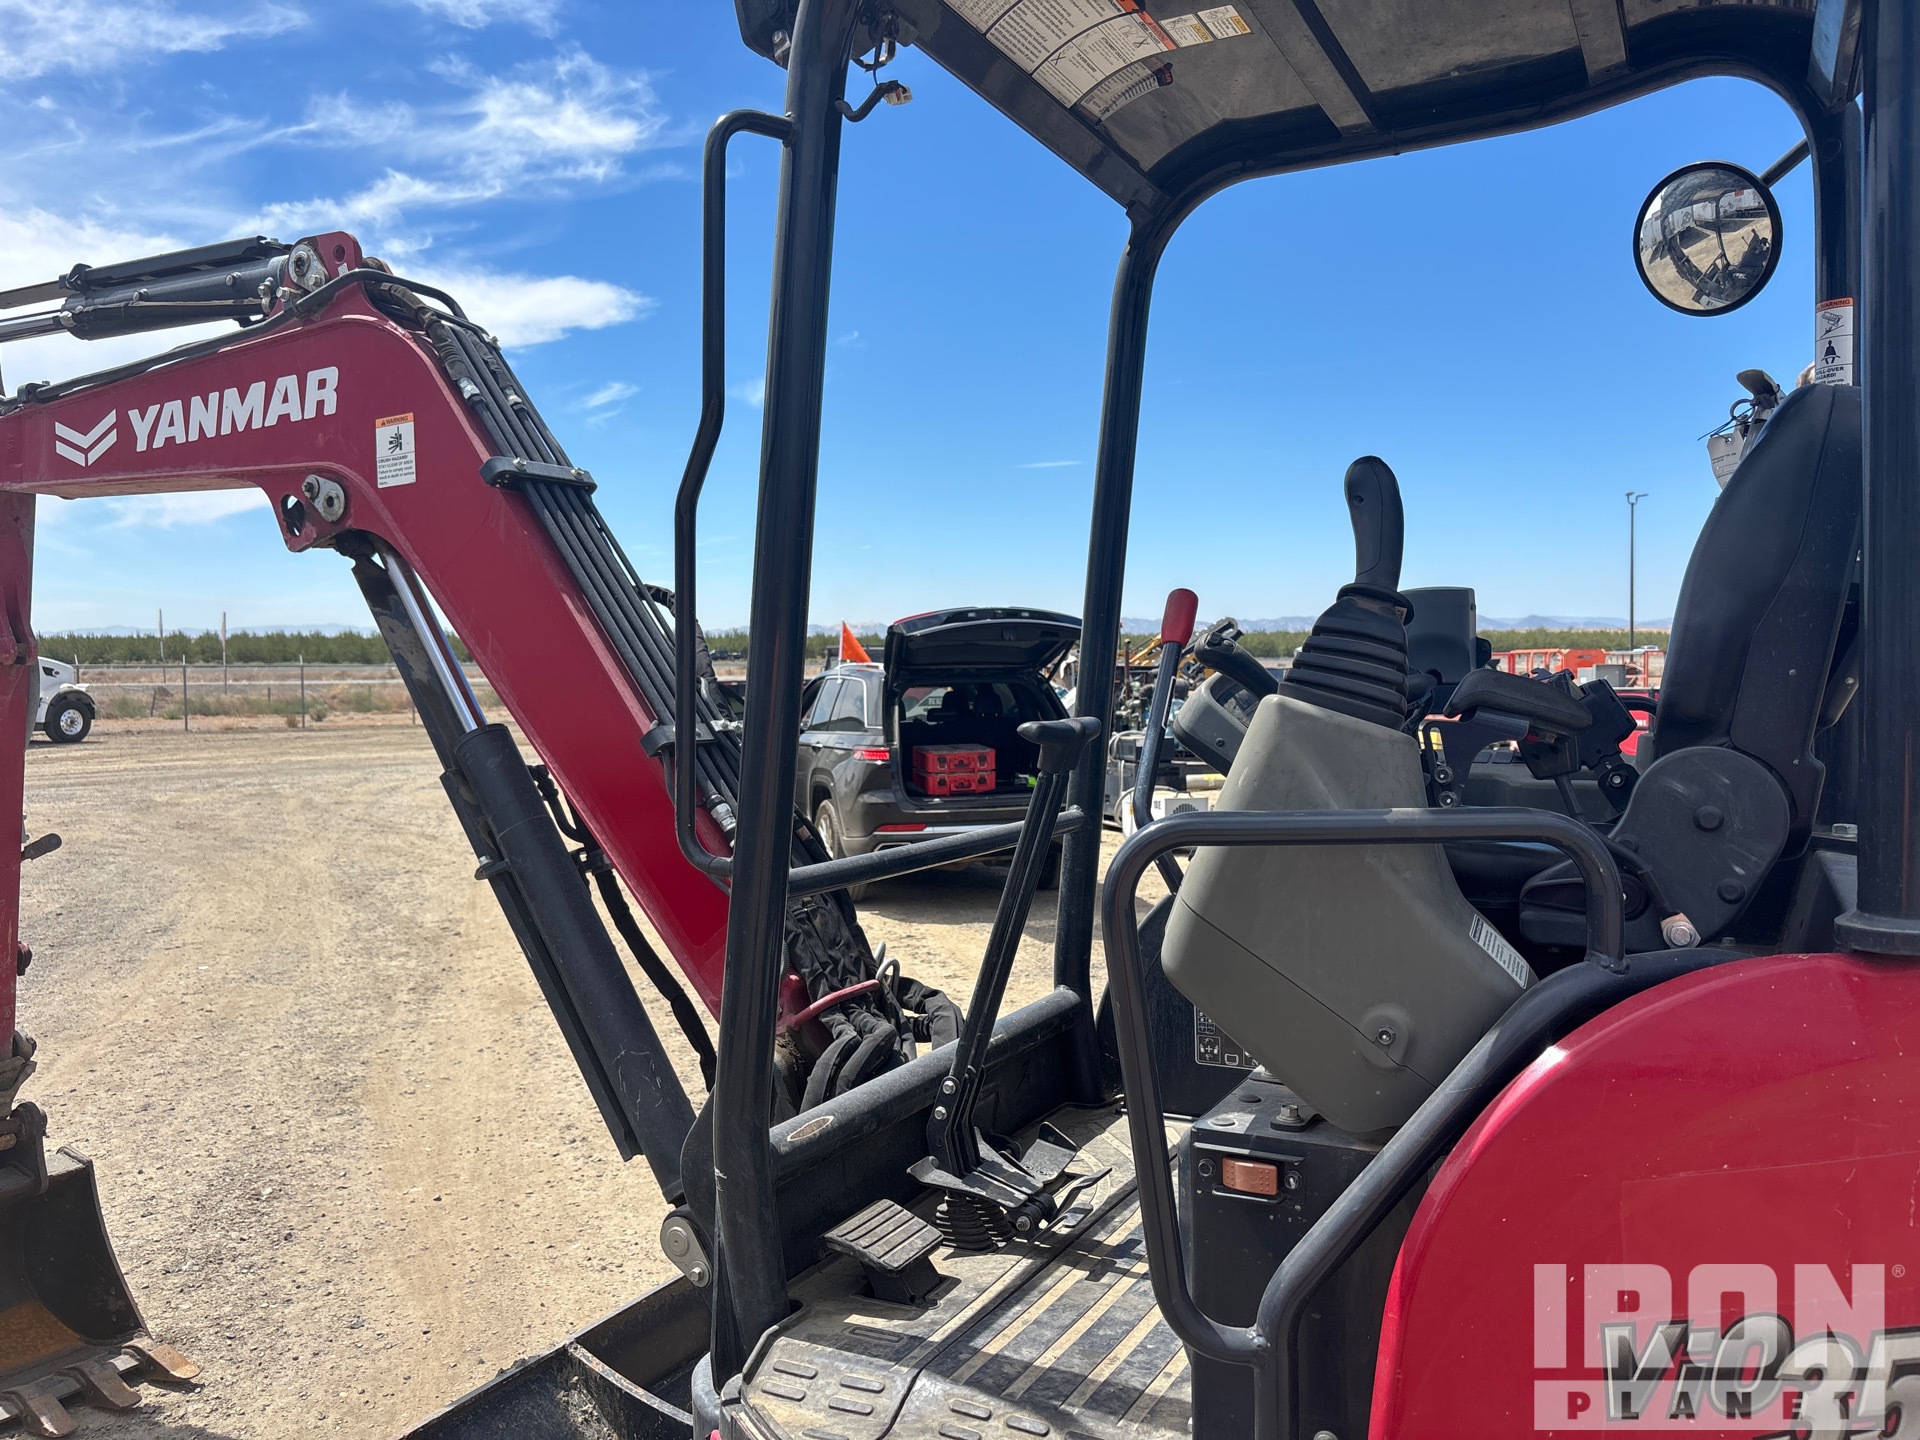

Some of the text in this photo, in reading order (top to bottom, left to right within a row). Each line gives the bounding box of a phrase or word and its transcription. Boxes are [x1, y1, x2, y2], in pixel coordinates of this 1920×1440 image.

[1820, 299, 1850, 308] WARNING
[1816, 372, 1836, 380] AZARD!
[128, 366, 339, 452] YANMAR
[386, 416, 408, 424] WARNING
